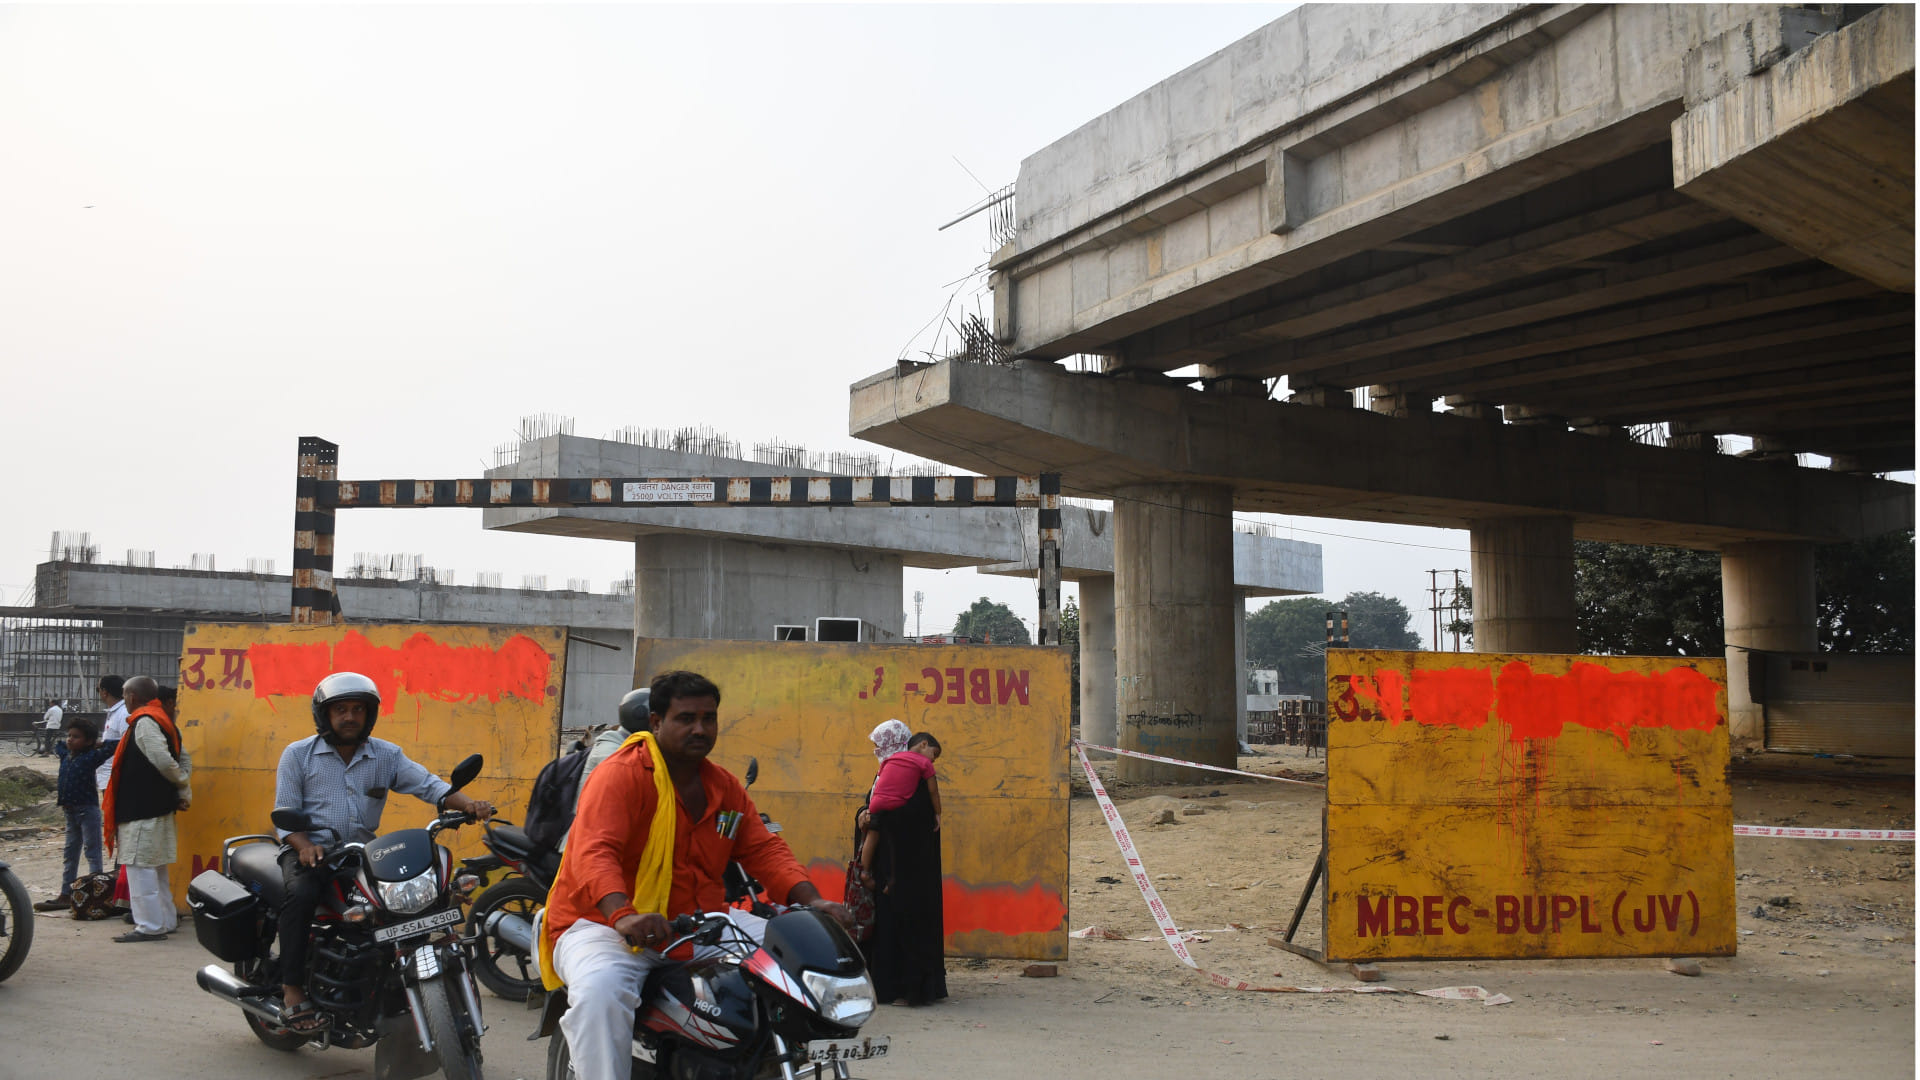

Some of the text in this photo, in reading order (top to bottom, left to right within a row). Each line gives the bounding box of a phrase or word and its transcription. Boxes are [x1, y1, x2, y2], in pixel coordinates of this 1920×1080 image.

[661, 483, 690, 491] DANGER
[182, 647, 253, 690] उ.प्र.
[693, 998, 722, 1017] Hero
